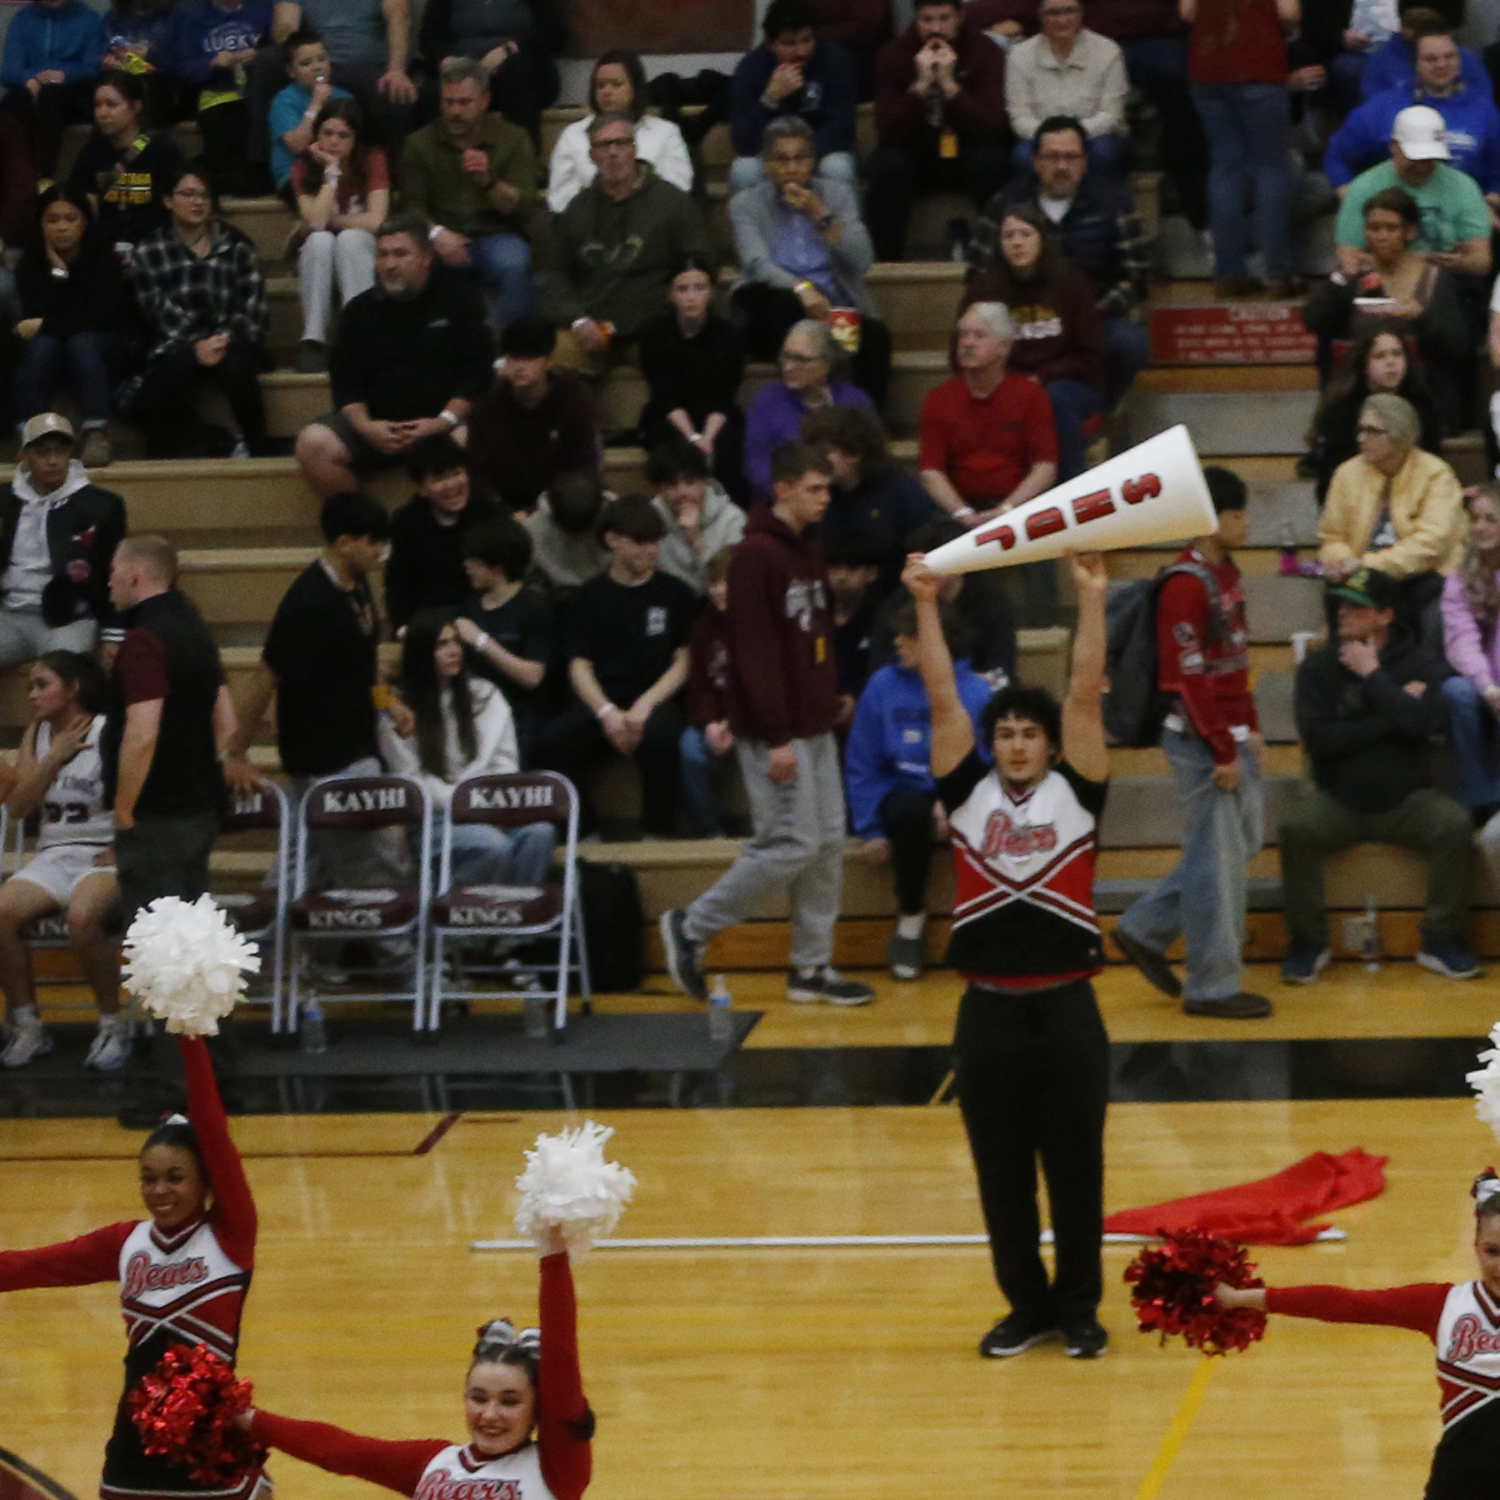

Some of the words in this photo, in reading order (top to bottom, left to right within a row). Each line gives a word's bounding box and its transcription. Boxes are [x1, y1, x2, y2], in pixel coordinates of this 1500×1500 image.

[975, 472, 1163, 551] JDHS
[322, 786, 406, 813] KAYHI
[468, 785, 554, 809] KAYHI
[307, 907, 383, 928] KINGS
[449, 905, 523, 925] KINGS
[121, 1250, 209, 1301] Bears
